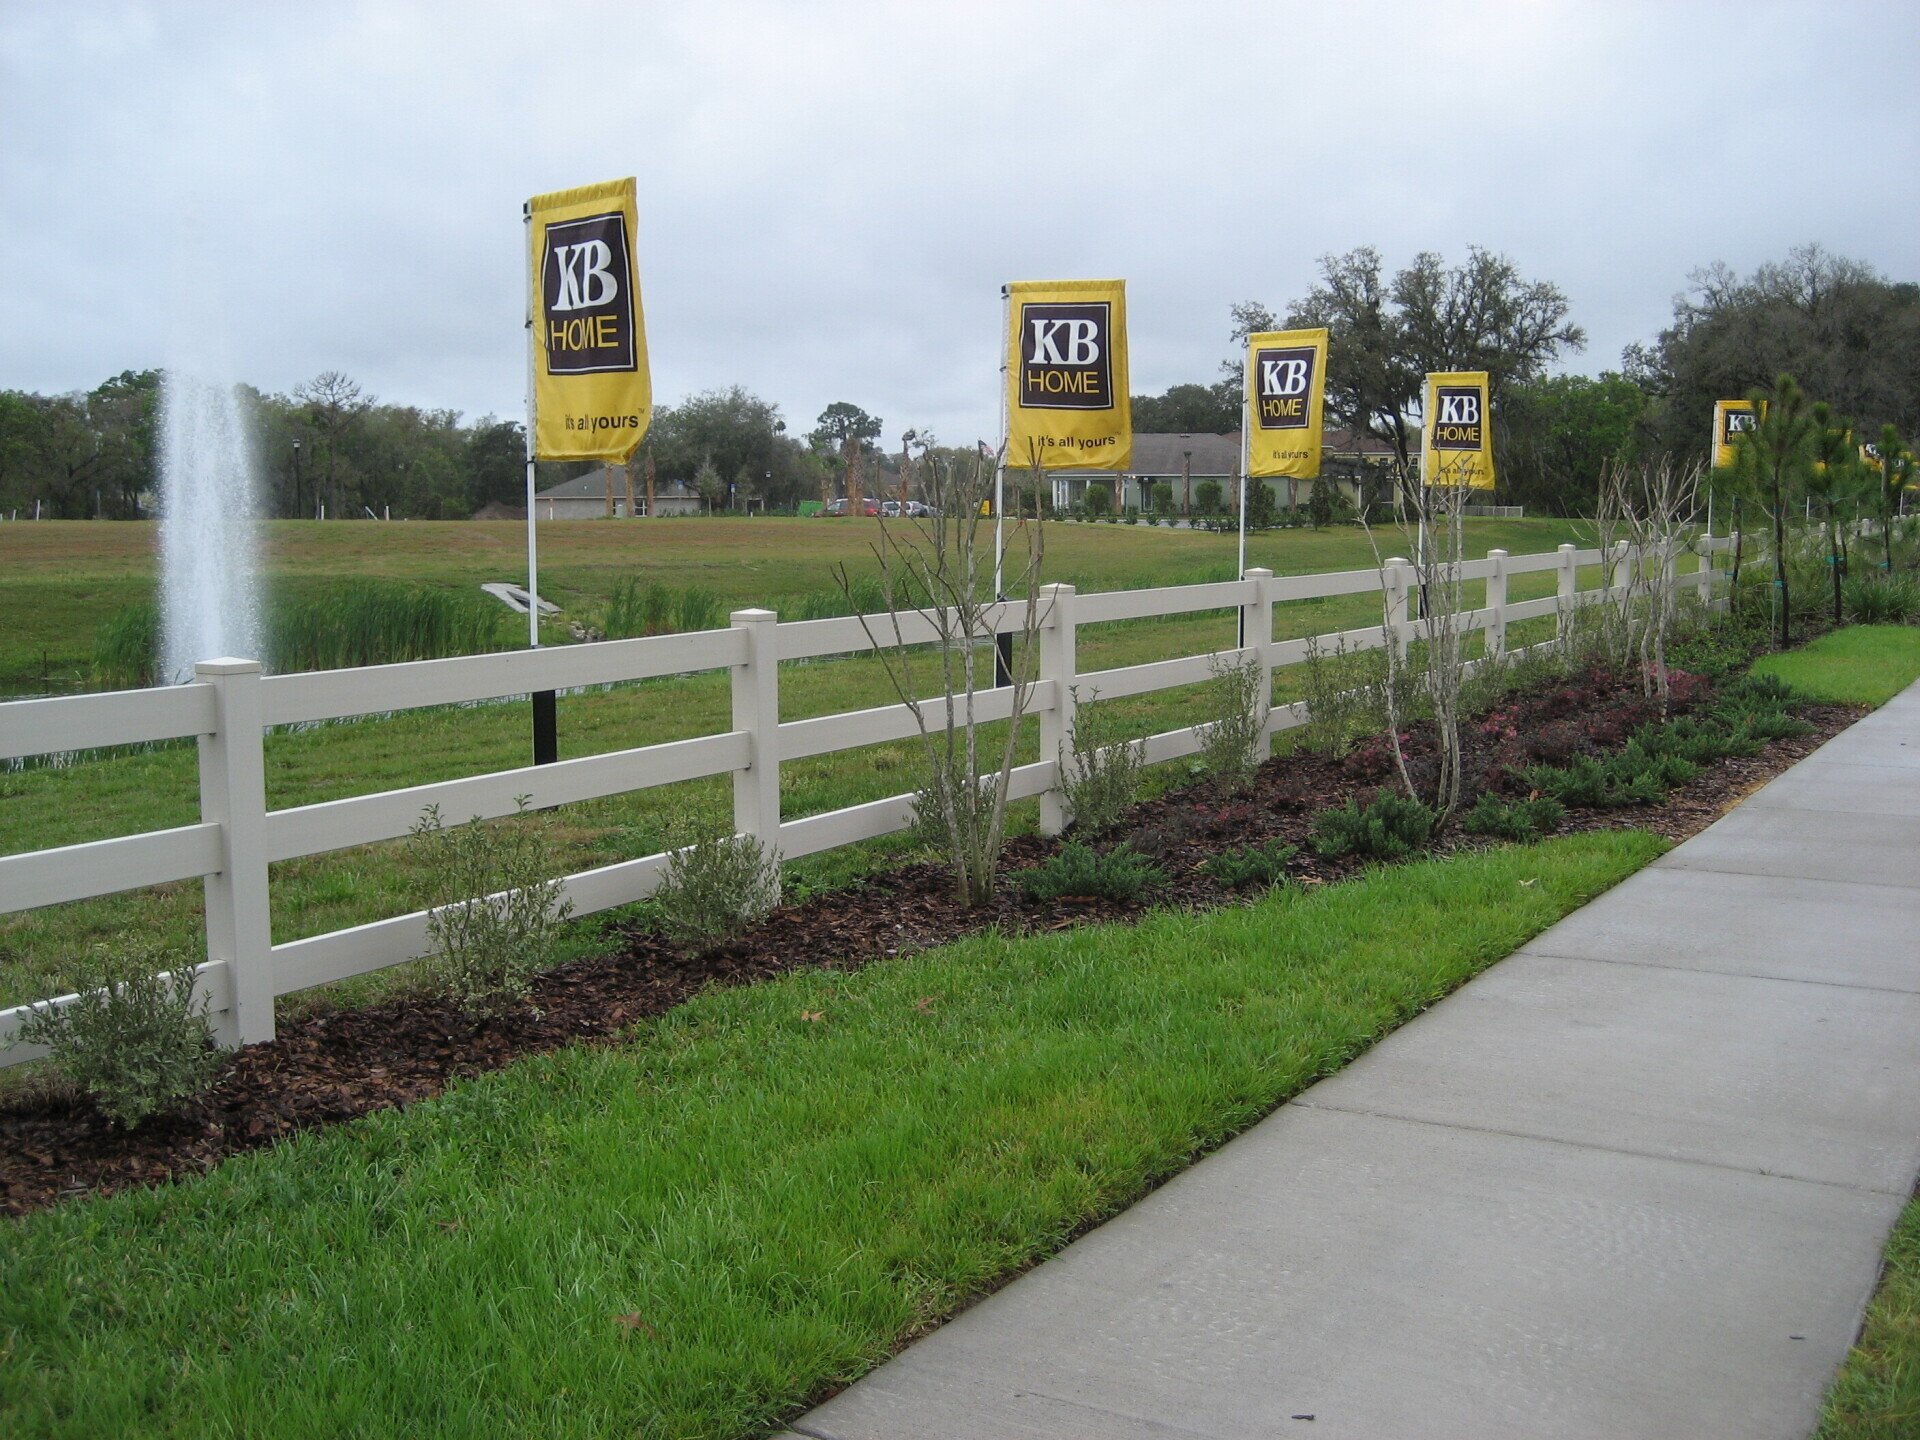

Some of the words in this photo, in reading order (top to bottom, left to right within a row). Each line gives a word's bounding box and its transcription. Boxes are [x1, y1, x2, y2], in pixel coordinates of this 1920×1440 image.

[551, 239, 618, 311] KB
[1028, 319, 1099, 365] KB
[1027, 370, 1099, 394] HOME
[1262, 359, 1307, 396] KB
[1262, 398, 1302, 417] HOME
[1438, 395, 1479, 424] KB
[591, 415, 638, 434] yours
[1436, 426, 1479, 442] HOME
[1037, 435, 1055, 447] it's
[1058, 436, 1074, 447] all
[1078, 436, 1116, 450] yours
